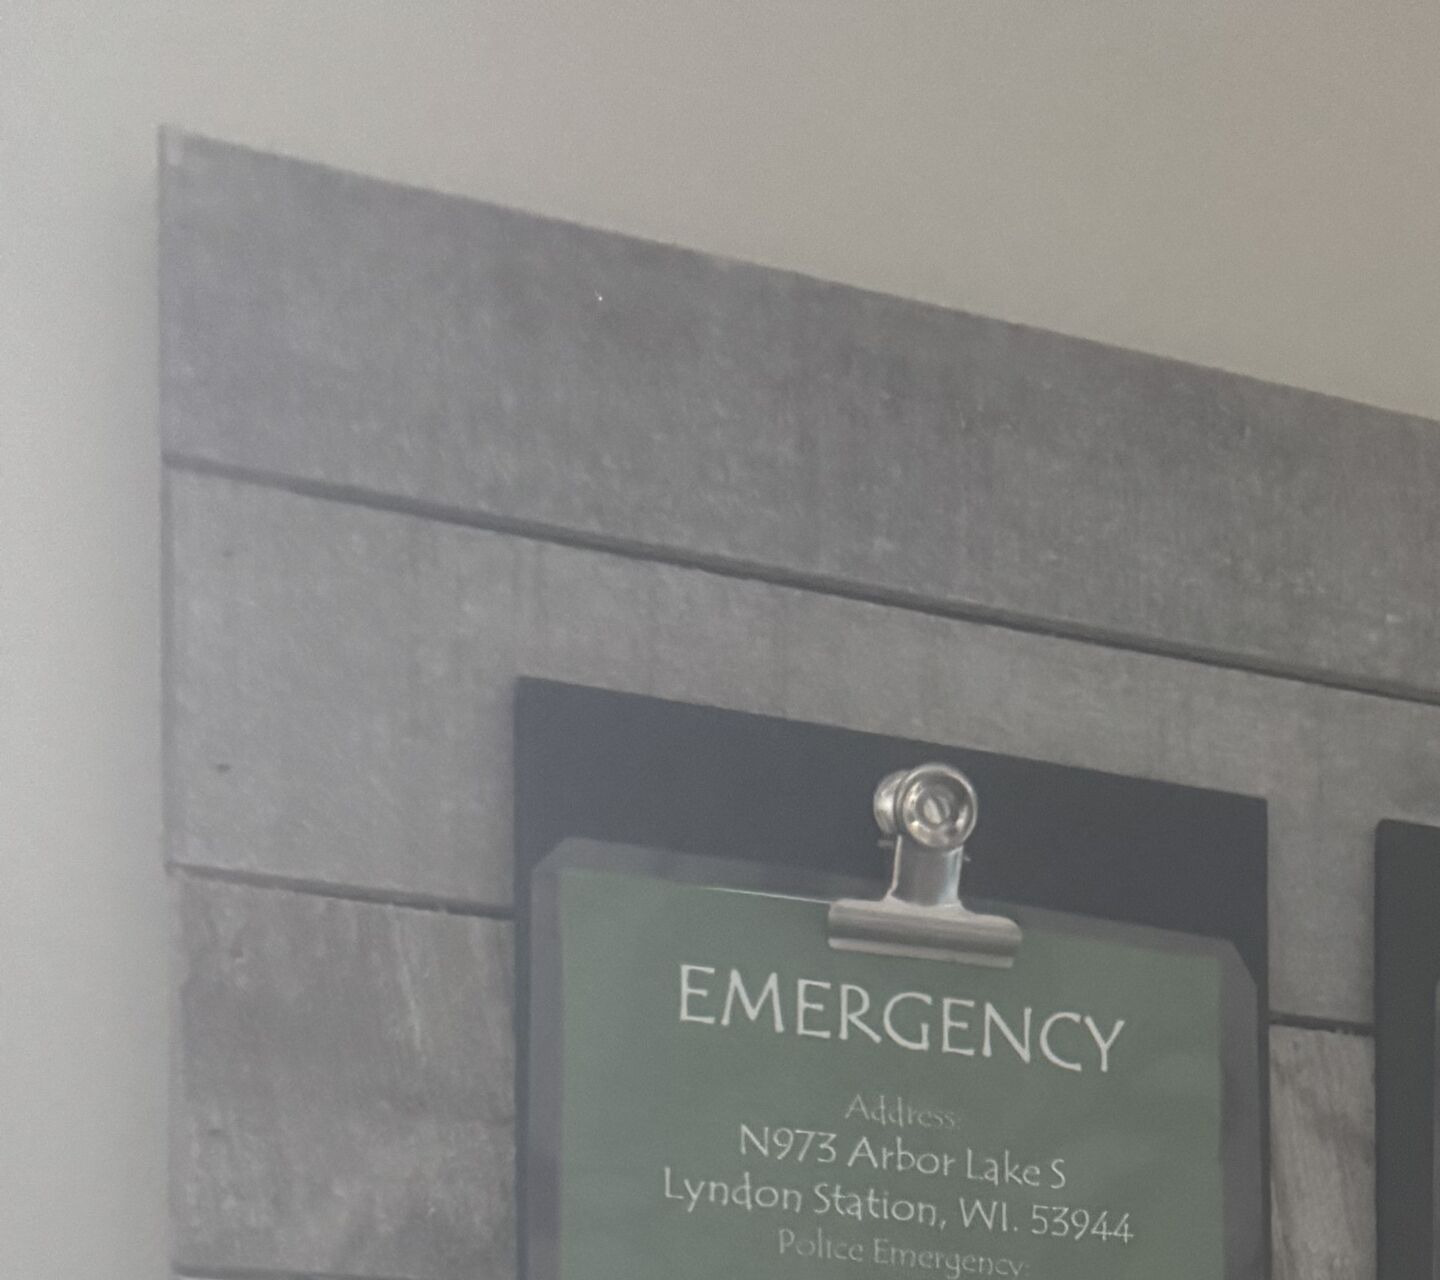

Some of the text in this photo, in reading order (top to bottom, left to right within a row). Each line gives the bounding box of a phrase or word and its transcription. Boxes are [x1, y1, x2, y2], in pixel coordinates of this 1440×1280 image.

[678, 962, 1128, 1074] EMERGENCY
[740, 1123, 1067, 1190] N973 Arbor Lake S
[664, 1165, 1136, 1247] Lyndon Station, WI. 53944
[778, 1227, 864, 1263] Police
